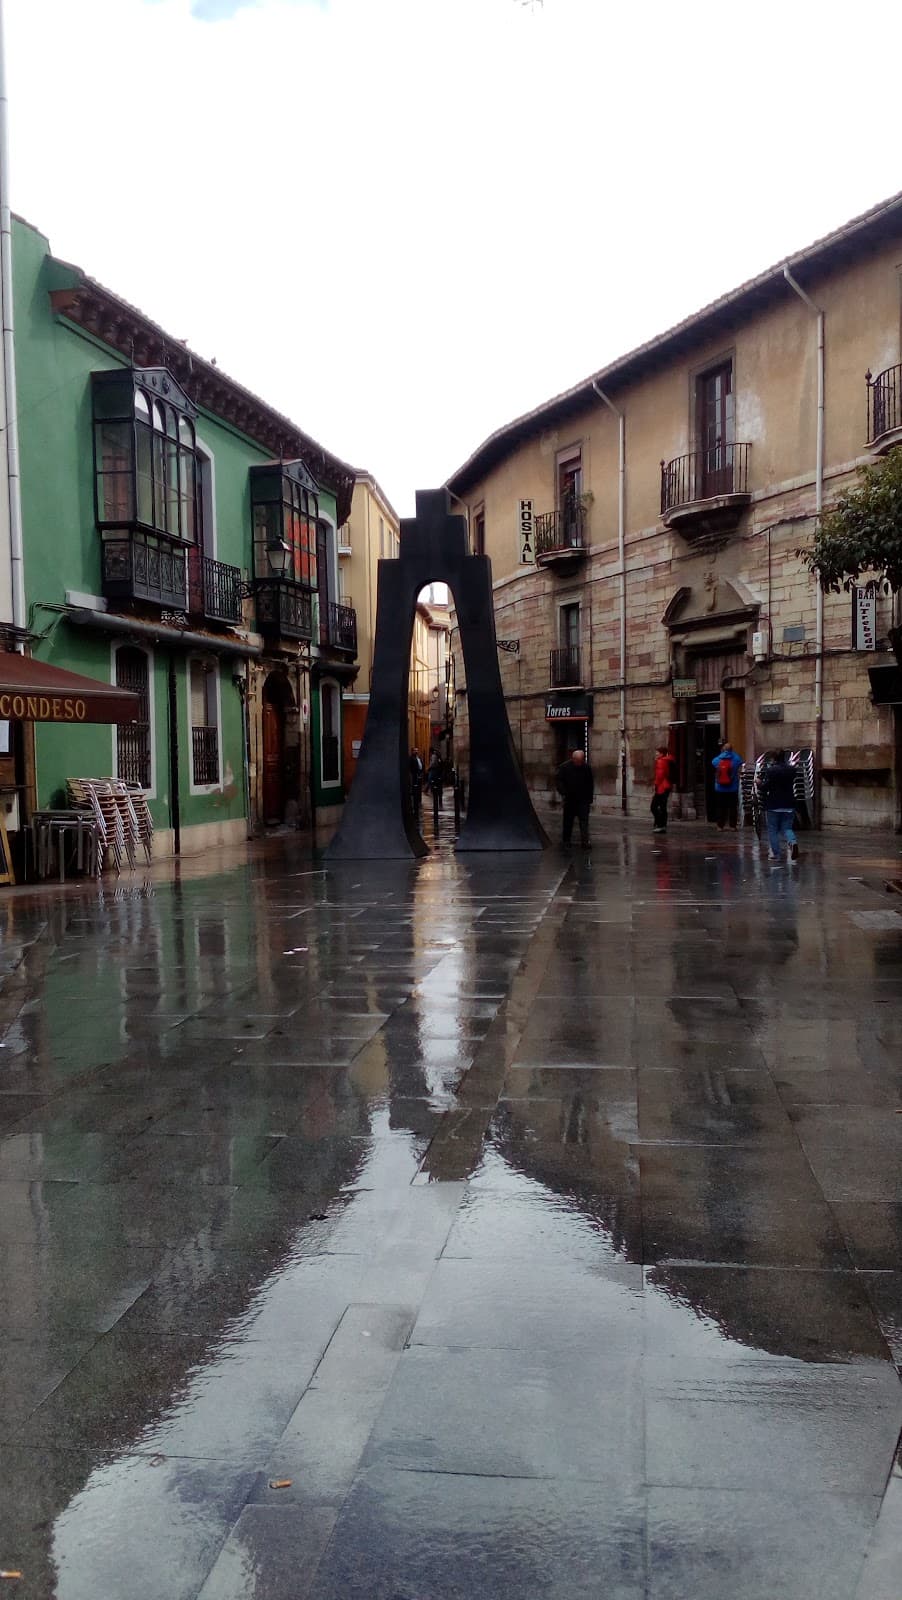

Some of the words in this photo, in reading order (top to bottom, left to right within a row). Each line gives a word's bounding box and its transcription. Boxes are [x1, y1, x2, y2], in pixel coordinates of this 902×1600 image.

[521, 500, 533, 563] HOSTAL
[858, 589, 875, 600] BAR
[0, 694, 86, 720] CONDESO
[546, 704, 571, 717] Torres
